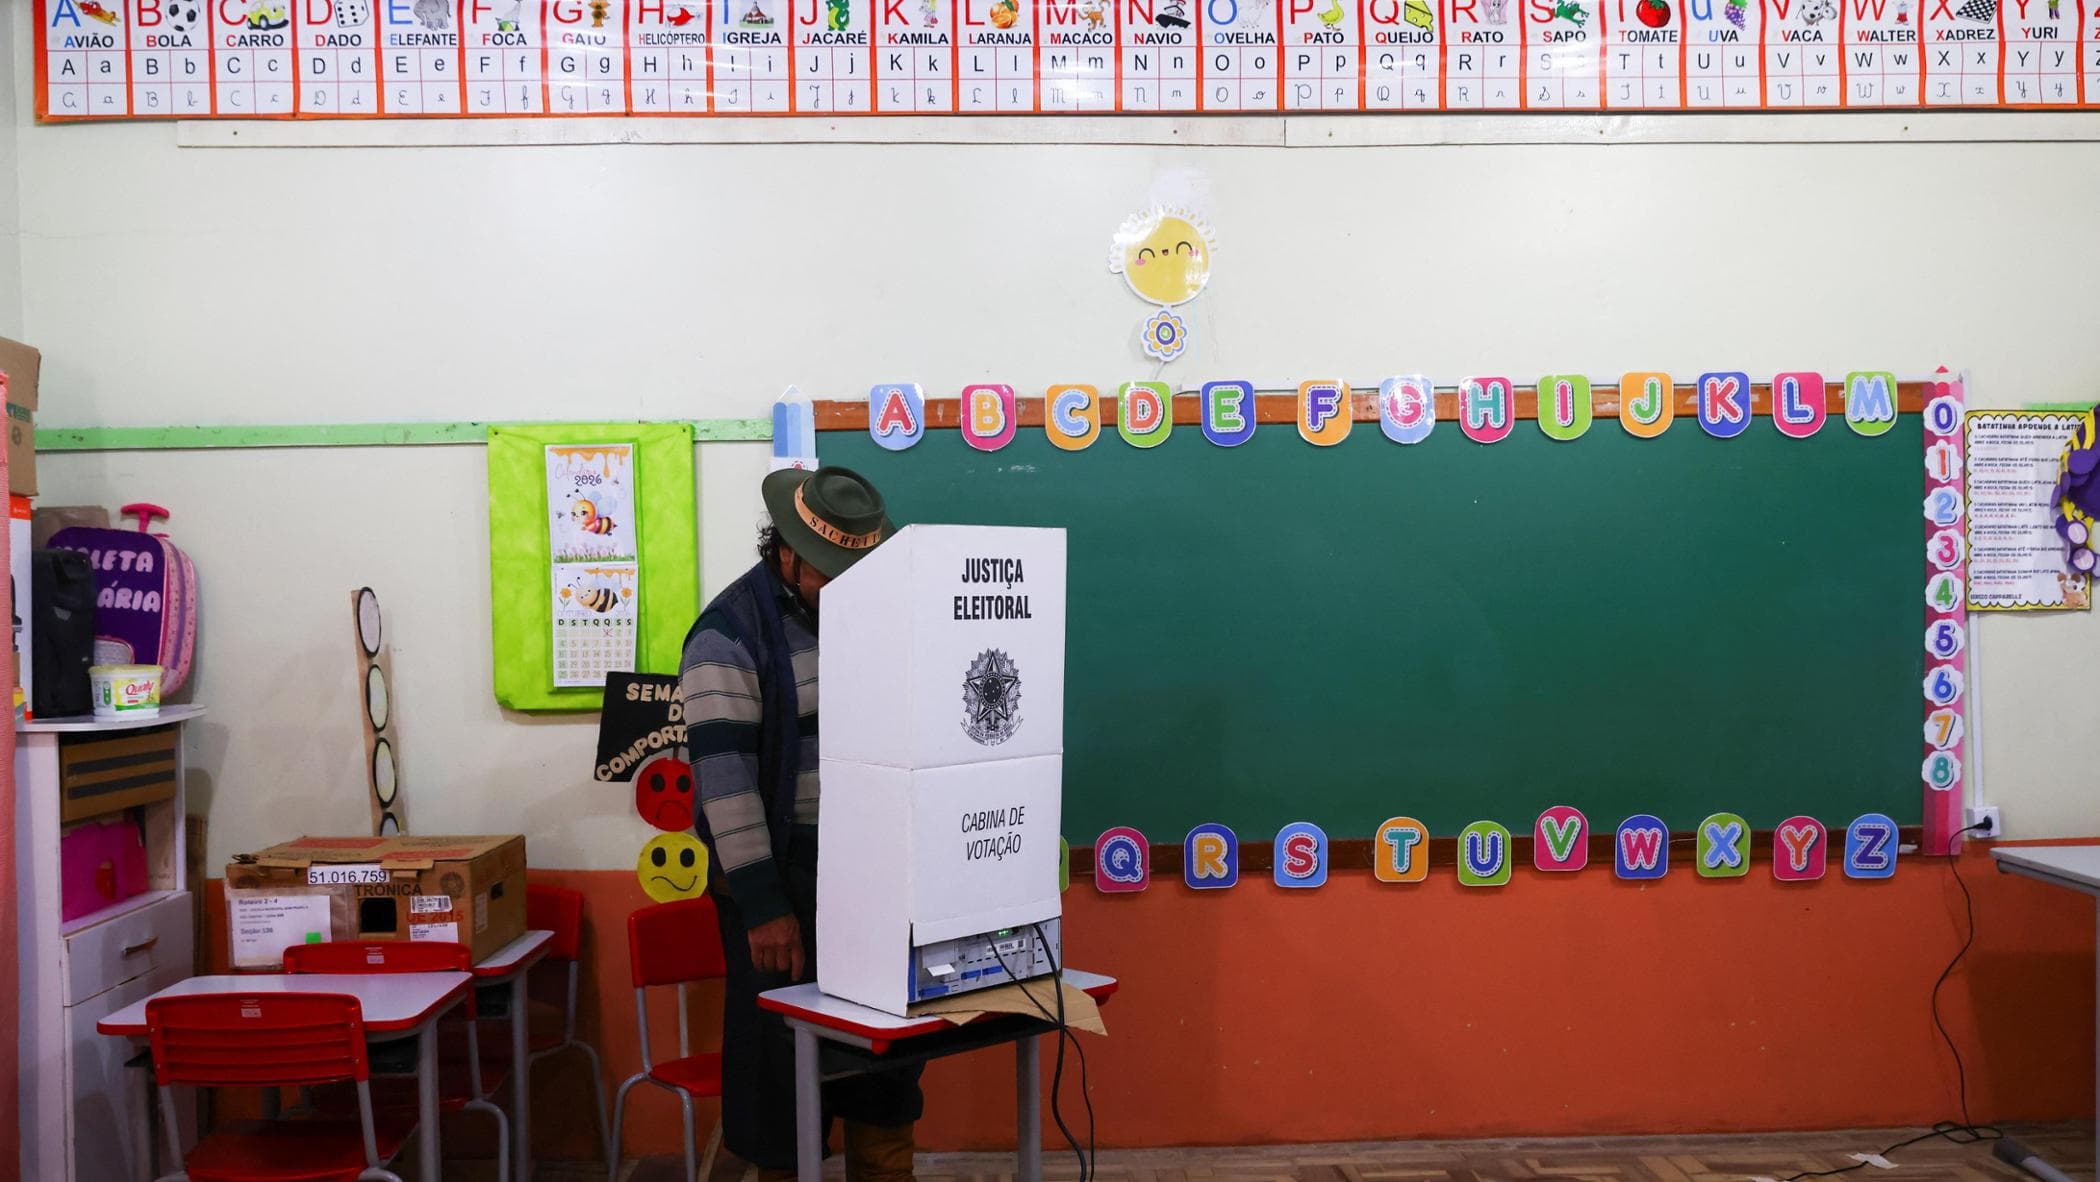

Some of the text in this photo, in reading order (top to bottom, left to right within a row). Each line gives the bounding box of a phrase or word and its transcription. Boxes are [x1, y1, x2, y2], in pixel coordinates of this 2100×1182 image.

[64, 33, 114, 47] AVIÃO
[146, 35, 192, 47] BOLA
[226, 34, 284, 47] CARRO
[315, 34, 361, 47] DADO
[390, 33, 457, 46] ELEFANTE
[483, 33, 527, 46] FOCA
[639, 31, 705, 45] HELICÓPTERO
[723, 32, 781, 44] IGREJA
[802, 30, 867, 44] JACARÉ
[888, 33, 949, 44] KAMILA
[969, 33, 1032, 44] LARANJA
[1050, 33, 1113, 44] MACACO
[1134, 33, 1182, 44] NAVIO
[1214, 33, 1275, 44] OVELHA
[1304, 33, 1344, 44] PATO
[1375, 31, 1434, 44] QUEIJO
[1461, 31, 1504, 43] RATO
[1543, 30, 1586, 43] SAPO
[1619, 30, 1678, 44] TOMATE
[1709, 30, 1739, 42] UVA
[1782, 29, 1823, 42] VACA
[1857, 30, 1916, 42] WALTER
[1936, 29, 1995, 41] XADREZ
[2021, 27, 2058, 39] YURI
[62, 59, 111, 75] A a
[146, 58, 195, 75] B b
[227, 57, 278, 73] C c
[313, 57, 361, 74] D d
[396, 56, 445, 73] E e
[480, 56, 525, 73] F f
[561, 56, 610, 73] G g
[810, 53, 853, 74] J j
[891, 54, 938, 71] K k
[974, 55, 984, 72] L
[1135, 54, 1183, 70] N n
[1215, 54, 1265, 71] O o
[1299, 55, 1346, 72] P p
[1459, 54, 1506, 70] R r
[1619, 54, 1663, 70] T t
[1698, 53, 1744, 69] U u
[1777, 53, 1825, 68] V v
[1855, 52, 1908, 67] W w
[1938, 51, 1986, 66] X x
[2018, 51, 2064, 67] Y y
[1385, 383, 1426, 427] G
[1467, 381, 1505, 428] H
[1555, 380, 1574, 426] I
[1630, 377, 1662, 424] J
[1705, 377, 1742, 424] K
[1782, 377, 1813, 423] L
[1849, 376, 1893, 422] M
[876, 388, 917, 436] A
[972, 388, 1004, 436] B
[1052, 388, 1090, 436] C
[1126, 388, 1163, 433] D
[1209, 385, 1246, 433] E
[1307, 385, 1342, 431] F
[1934, 402, 1953, 430] 0
[1937, 448, 1947, 476] 1
[575, 474, 602, 486] 2026
[1936, 492, 1953, 520] 2
[1937, 535, 1956, 563] 3
[962, 558, 1024, 589] JUSTIÇA
[97, 580, 161, 613] ÁRIA
[1936, 578, 1953, 605] 4
[953, 595, 1032, 620] ELEITORAL
[1935, 625, 1953, 652] 5
[1934, 671, 1952, 698] 6
[668, 704, 687, 722] D
[1934, 714, 1952, 744] 7
[1933, 756, 1950, 784] 8
[961, 806, 1025, 833] CABINA DE
[966, 831, 1021, 861] VOTAÇÃO
[1541, 815, 1582, 862] V
[1704, 822, 1742, 867] X
[1853, 824, 1890, 869] Z
[1193, 833, 1228, 879] R
[1283, 832, 1317, 878] S
[1383, 827, 1420, 873] T
[1465, 831, 1502, 876] U
[1621, 828, 1662, 870] W
[1781, 825, 1818, 871] Y
[1100, 836, 1143, 882] Q
[309, 868, 388, 884] 51.016.759
